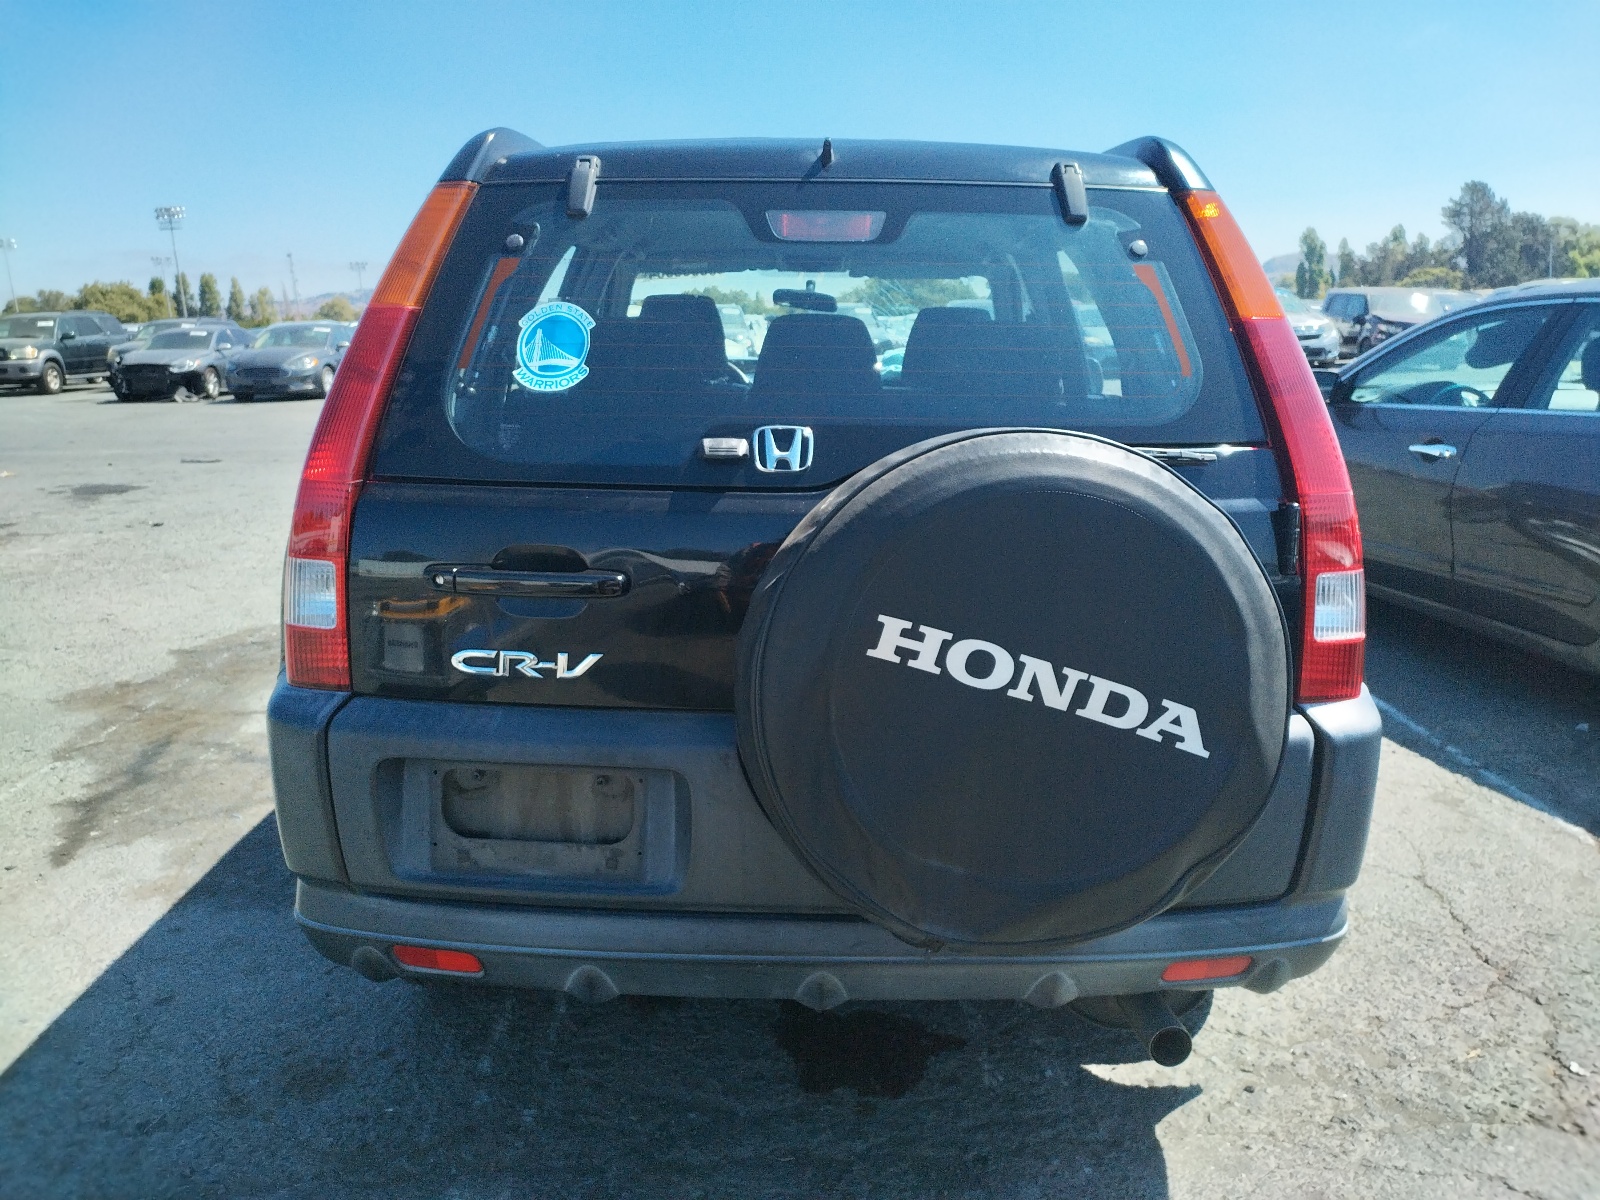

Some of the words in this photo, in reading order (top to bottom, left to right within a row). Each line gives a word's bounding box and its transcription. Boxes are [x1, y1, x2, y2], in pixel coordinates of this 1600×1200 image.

[521, 304, 563, 327] GOLDEN
[567, 305, 594, 328] STATE
[516, 366, 588, 390] WARRIORS
[451, 649, 604, 679] CR-V
[866, 614, 1210, 759] HONDA
